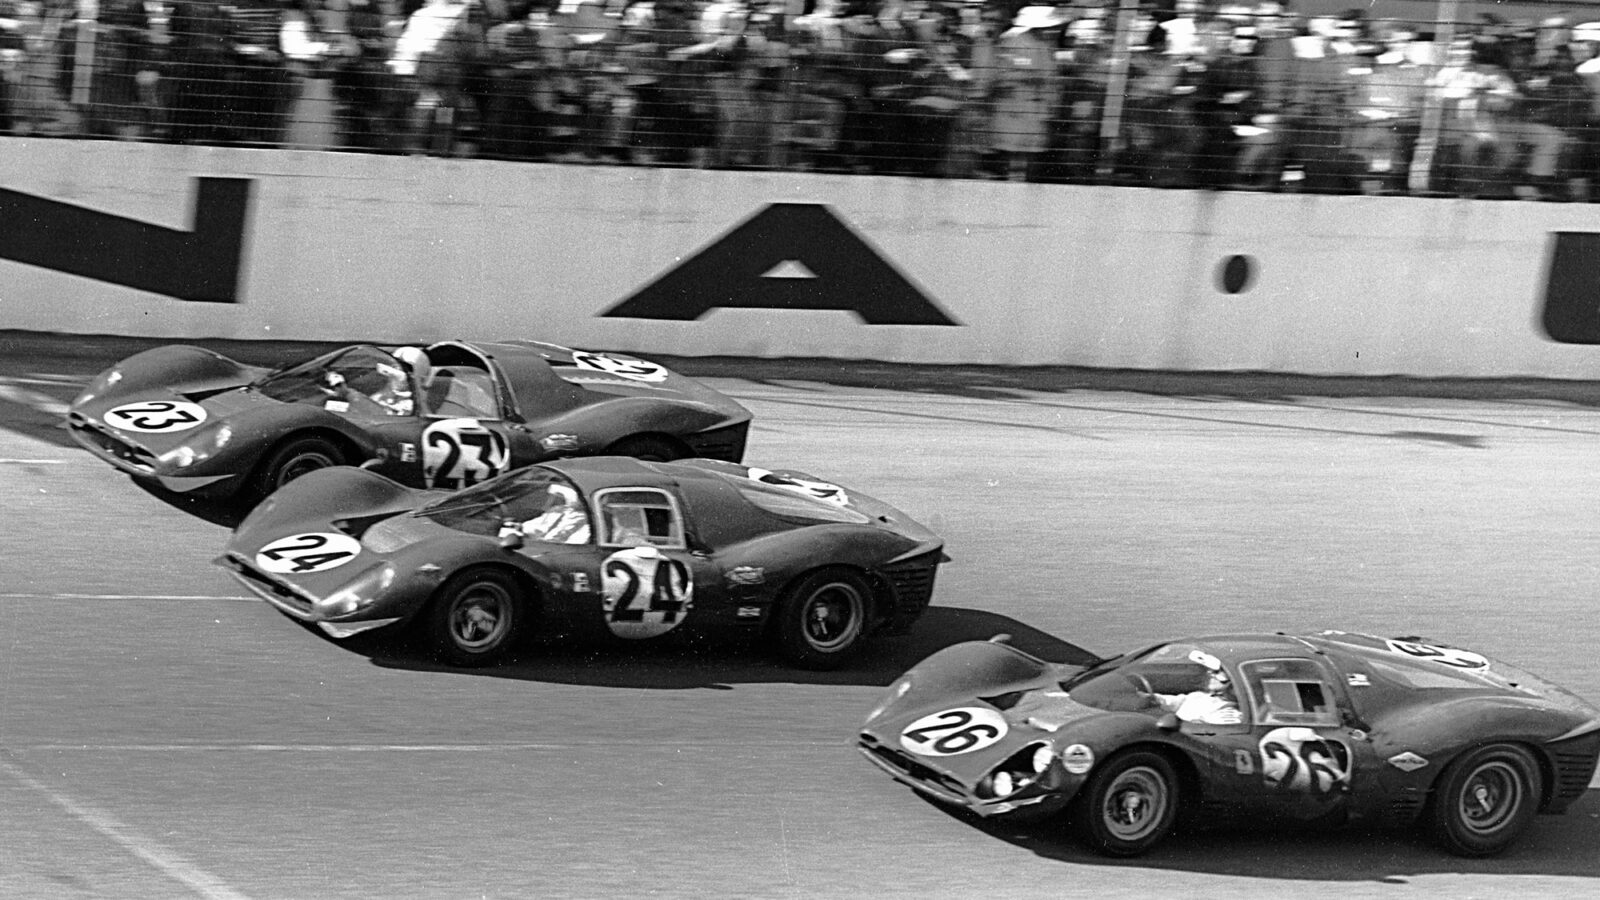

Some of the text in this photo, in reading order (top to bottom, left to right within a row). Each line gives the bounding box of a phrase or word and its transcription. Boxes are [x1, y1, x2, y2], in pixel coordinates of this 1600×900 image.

[112, 402, 199, 430] 23
[427, 430, 497, 489] 23
[261, 535, 354, 573] 24
[606, 559, 686, 624] 24
[902, 710, 999, 754] 26
[1263, 741, 1338, 793] 26
